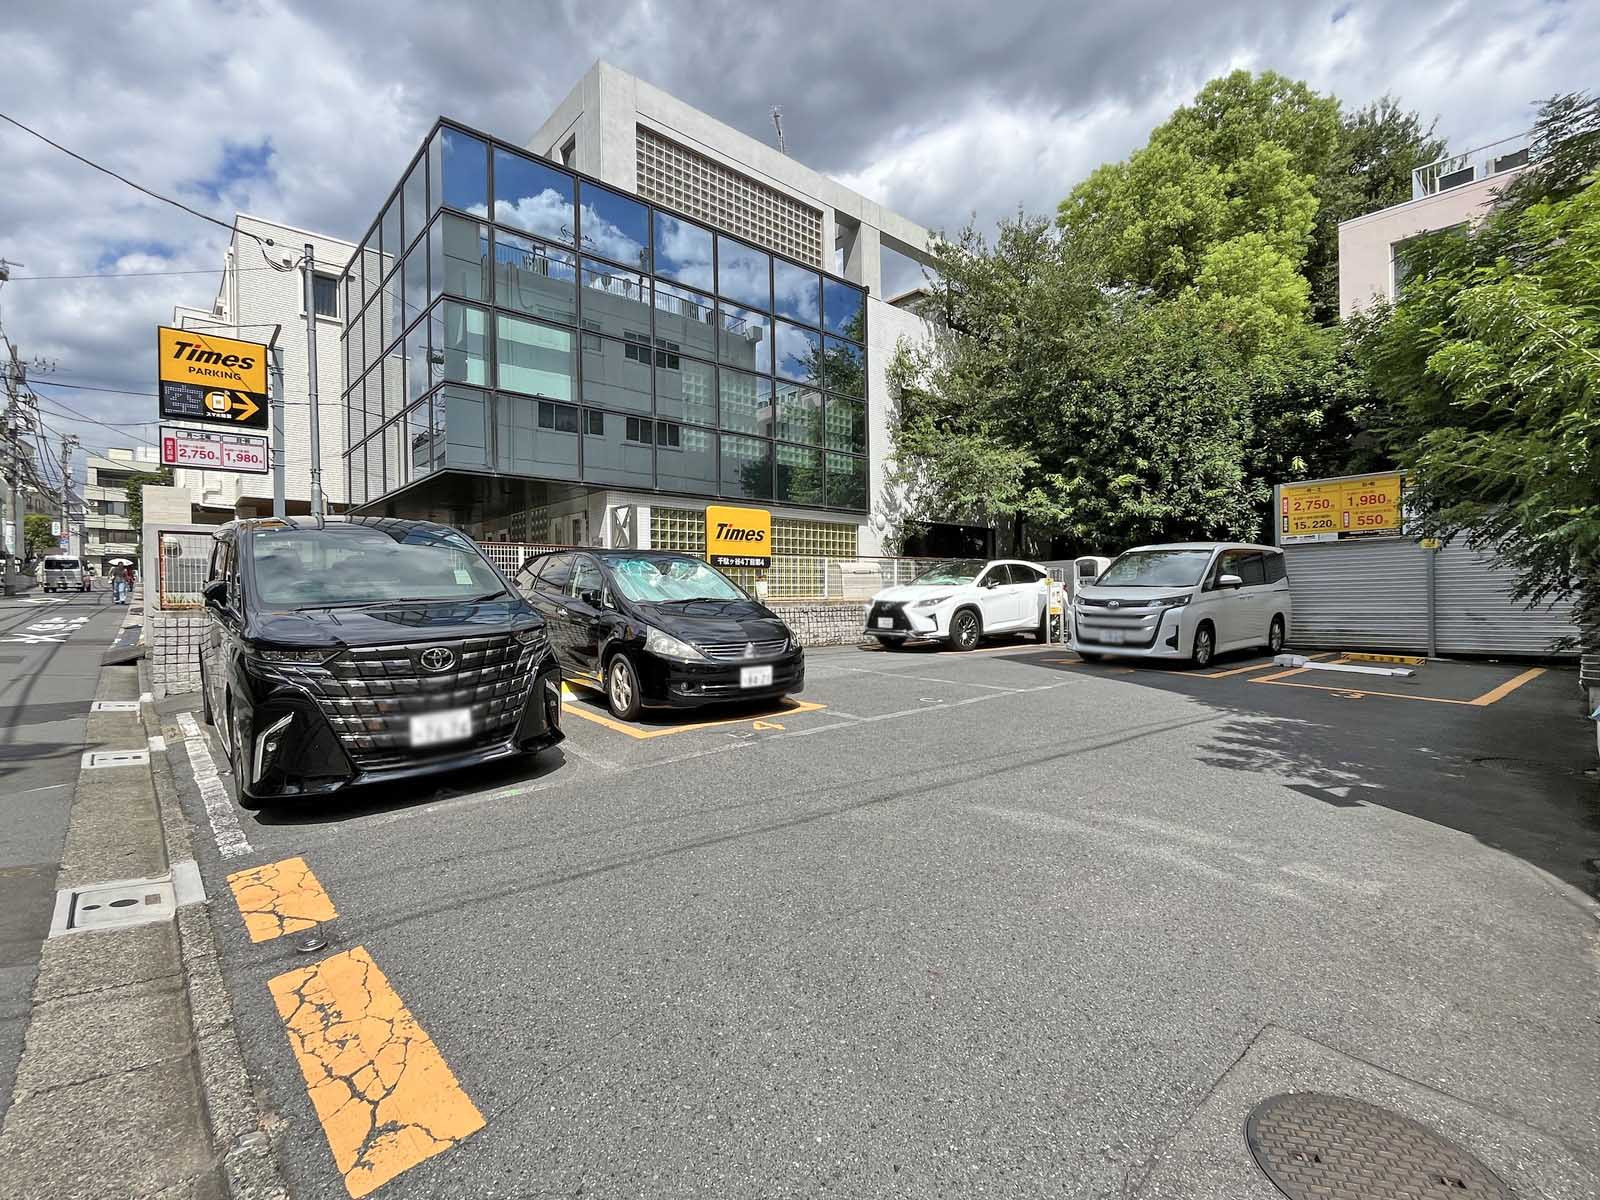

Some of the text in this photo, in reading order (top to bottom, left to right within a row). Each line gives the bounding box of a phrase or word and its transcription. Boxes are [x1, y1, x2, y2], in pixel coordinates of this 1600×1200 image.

[173, 341, 256, 370] Times
[188, 366, 241, 381] PARKING
[1294, 499, 1336, 512] 2,750
[1347, 493, 1392, 507] 1,980
[1294, 519, 1337, 530] 15,220
[1357, 514, 1389, 526] 550
[715, 523, 765, 542] Times
